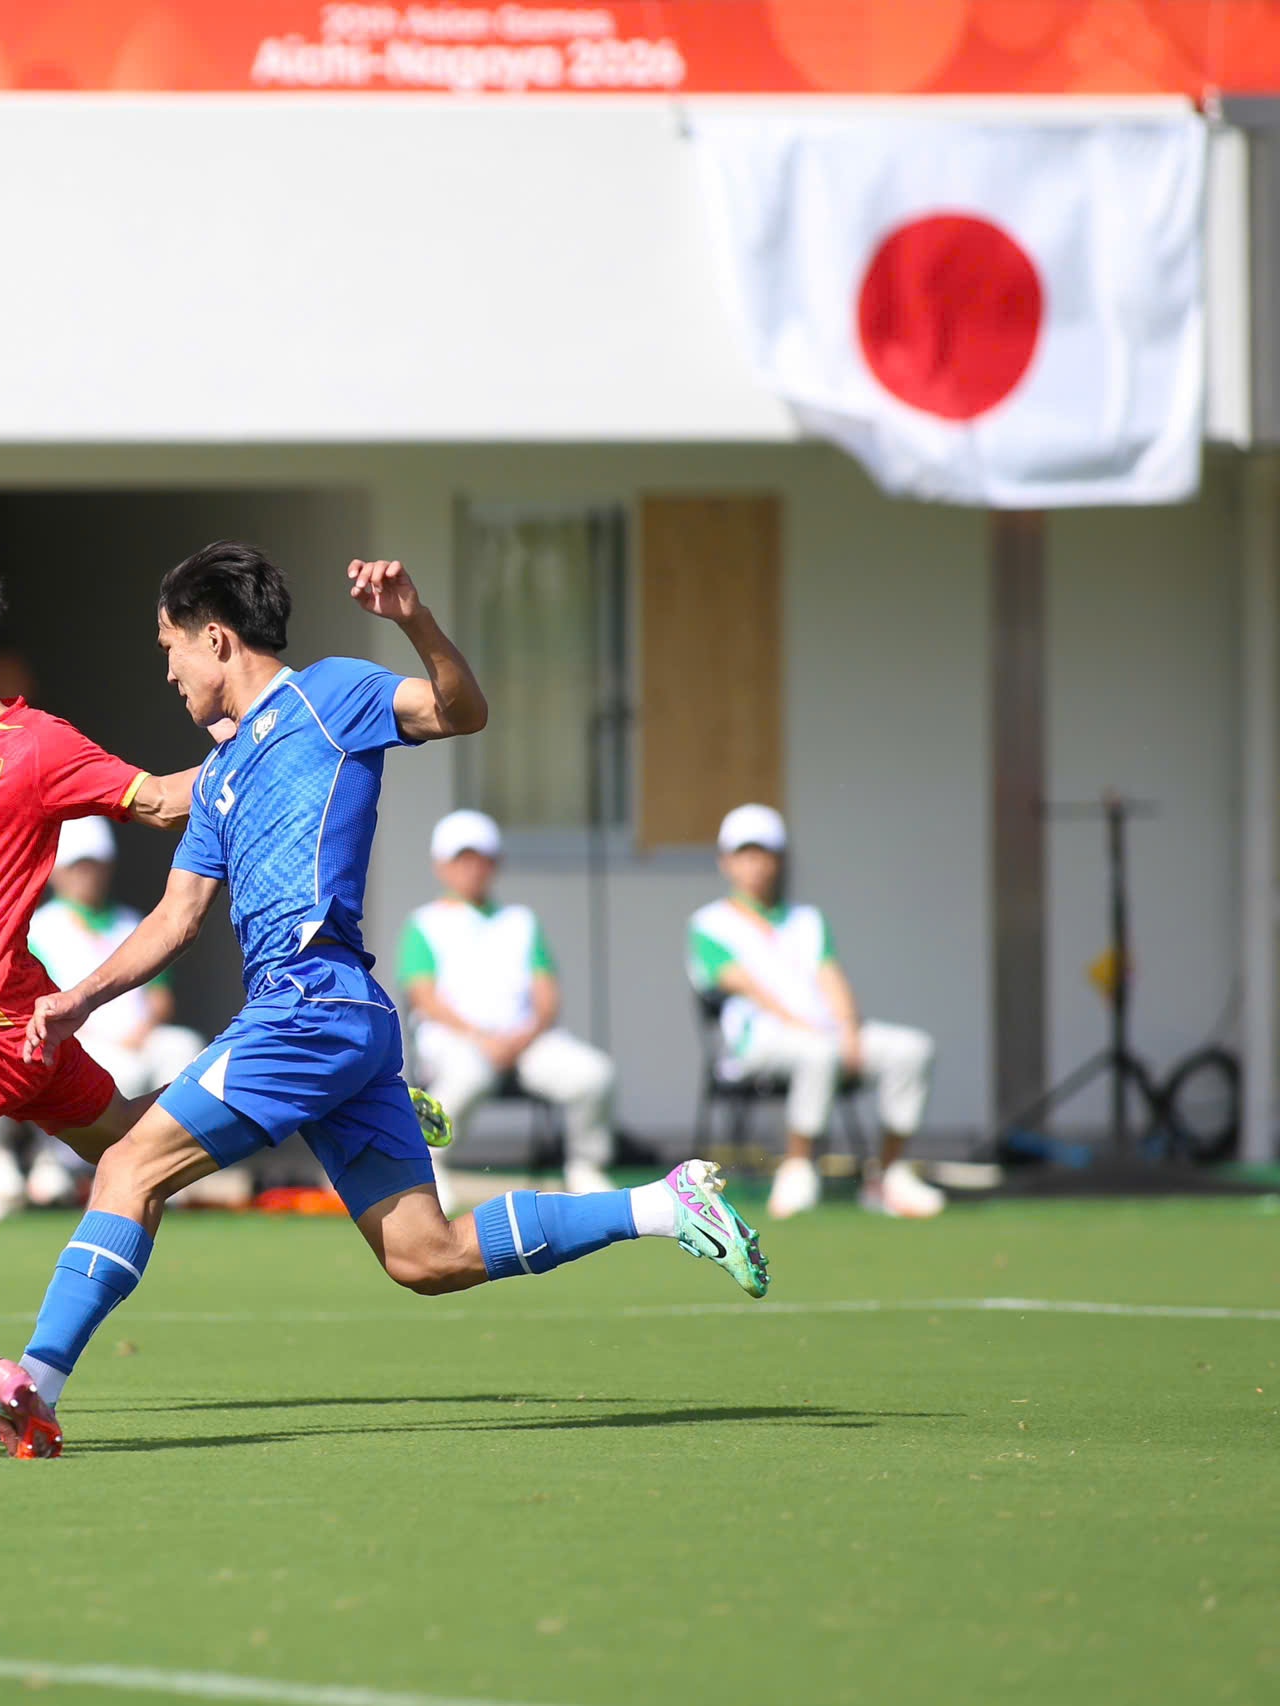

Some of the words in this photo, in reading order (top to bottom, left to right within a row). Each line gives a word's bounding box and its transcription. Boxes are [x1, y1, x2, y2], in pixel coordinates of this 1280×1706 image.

[405, 6, 491, 38] Asian
[497, 5, 615, 39] Games
[253, 36, 562, 91] Aichi-Nagoya
